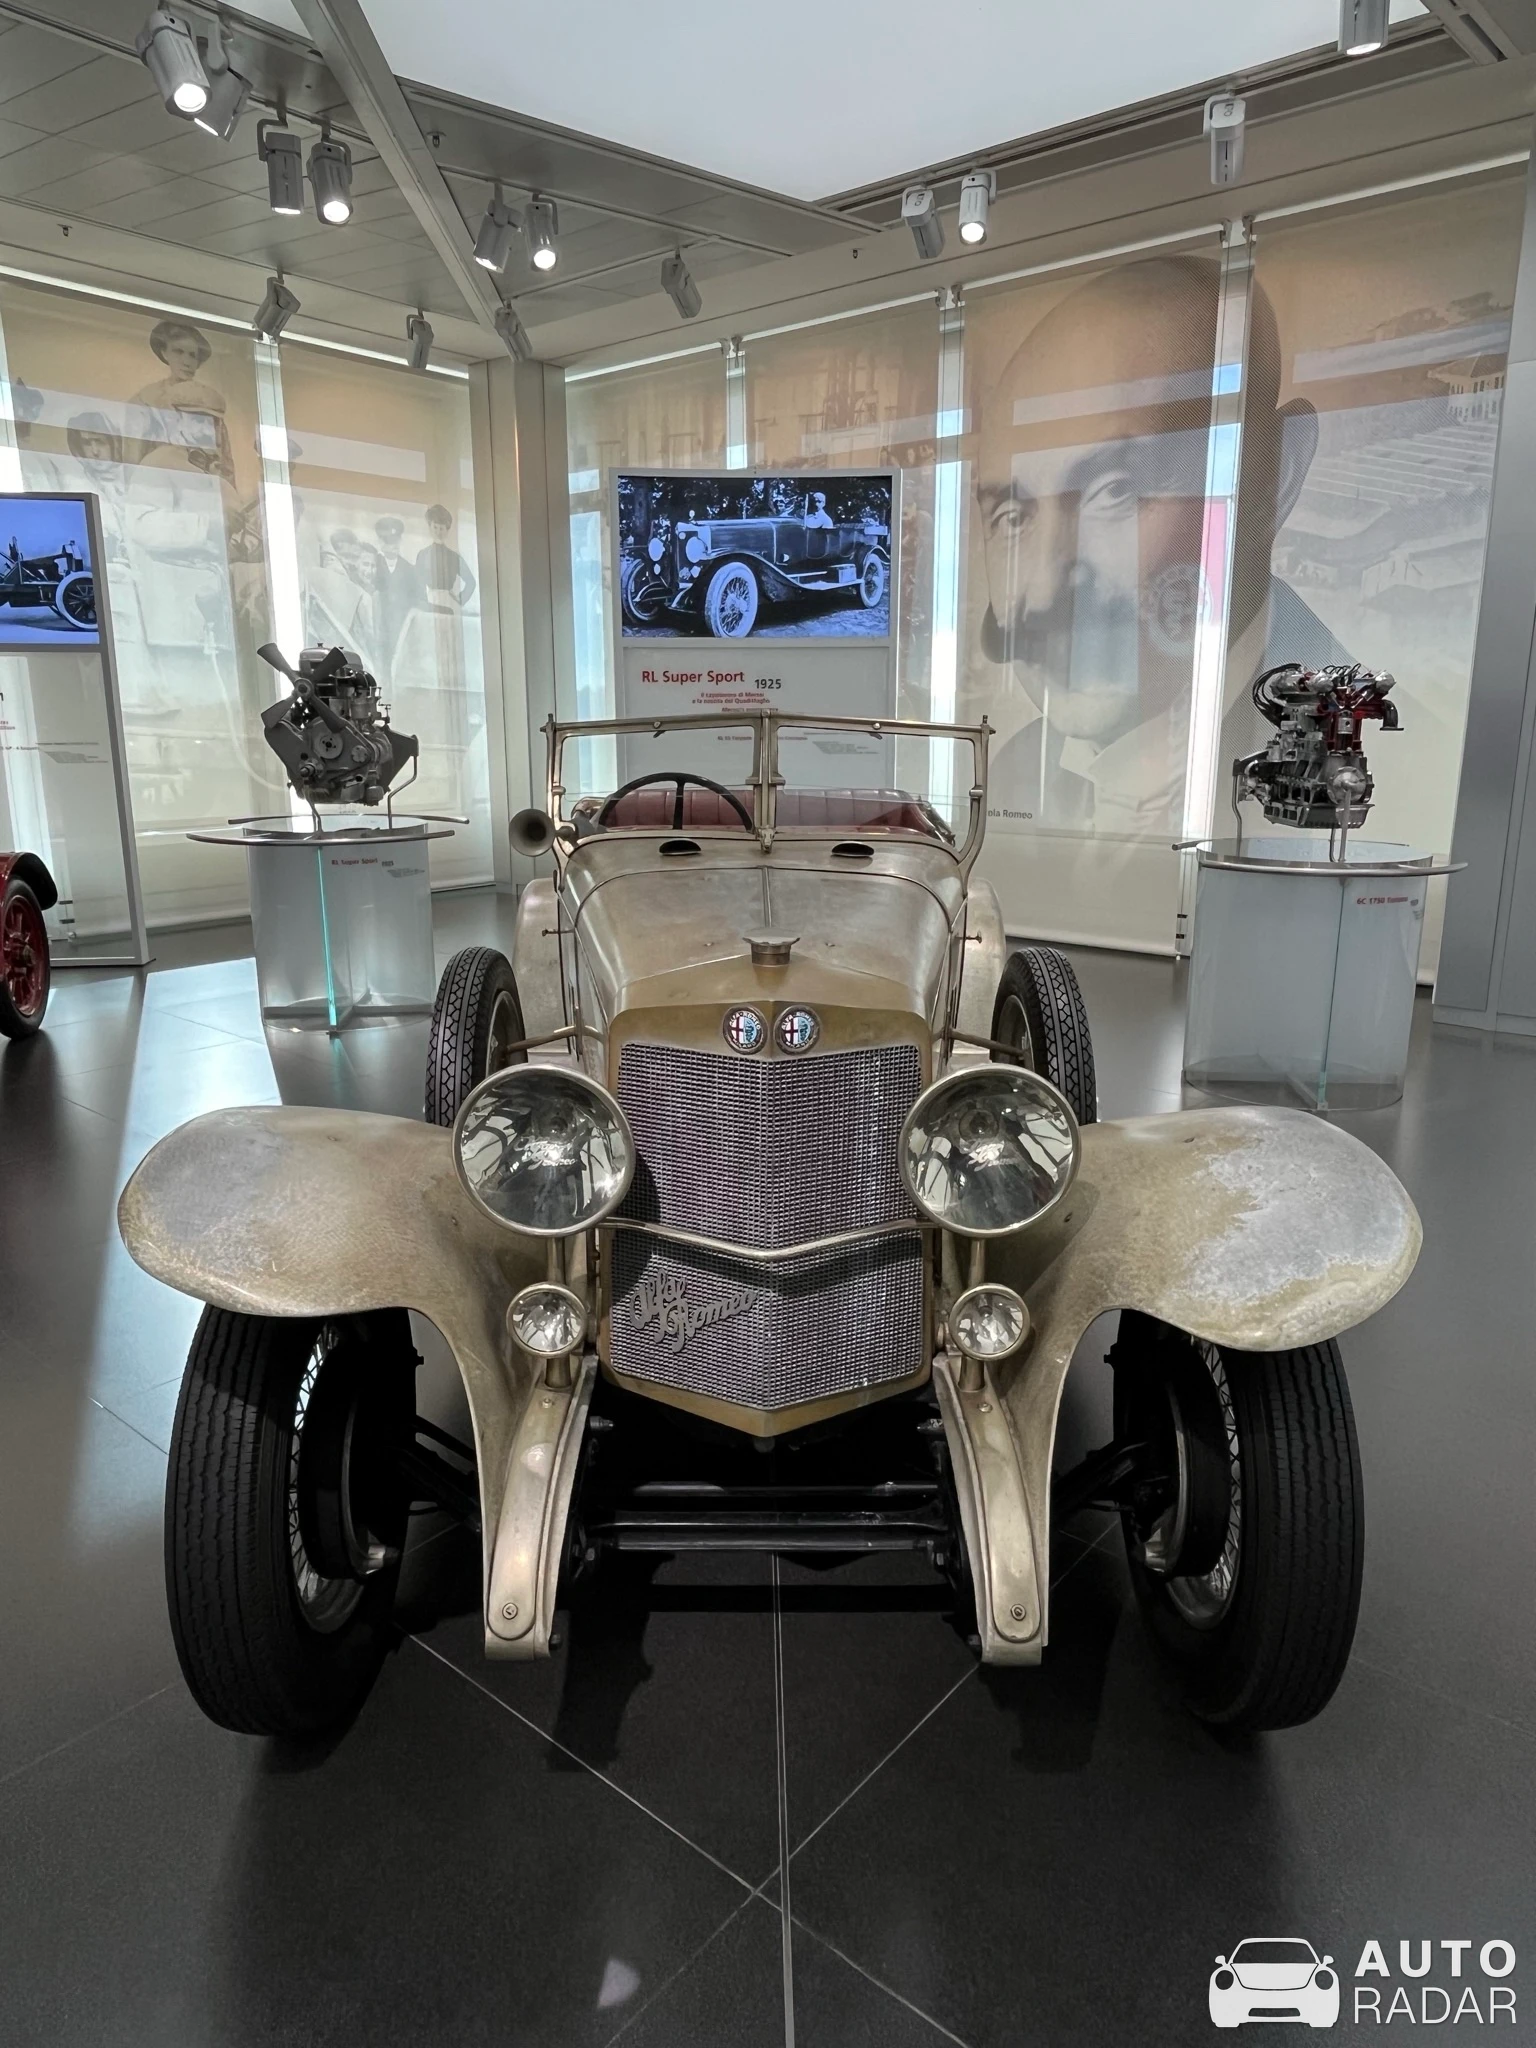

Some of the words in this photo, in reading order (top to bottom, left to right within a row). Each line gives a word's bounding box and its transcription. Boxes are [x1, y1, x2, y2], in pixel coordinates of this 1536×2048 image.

[642, 670, 658, 683] RL
[662, 670, 702, 686] Super
[707, 670, 745, 686] Sport
[754, 678, 782, 690] 1925
[1002, 809, 1033, 820] Romeo
[662, 1289, 759, 1352] Romeo
